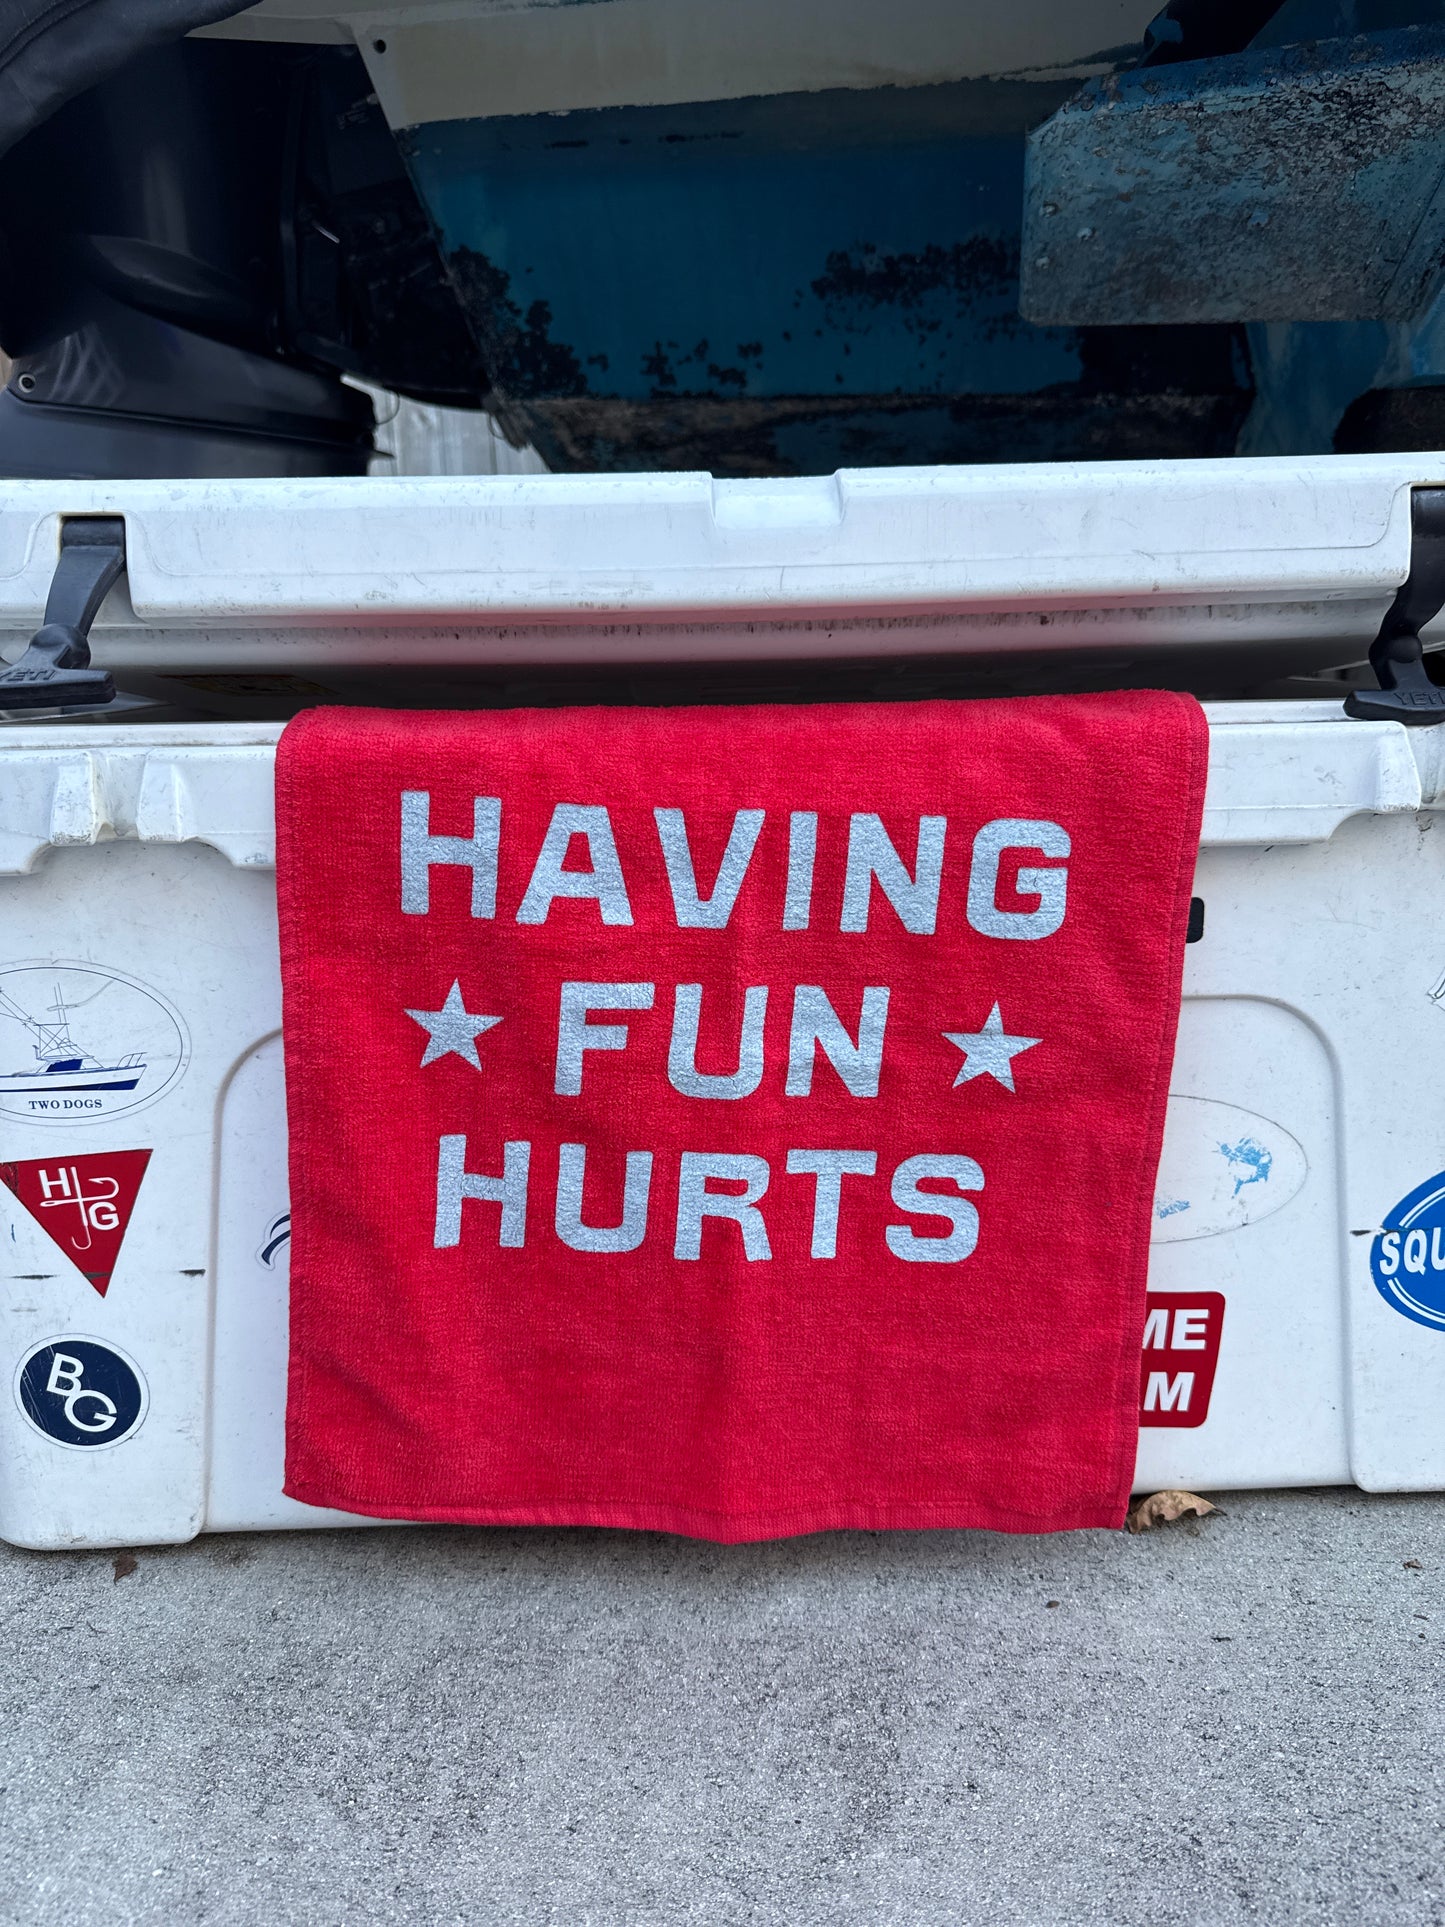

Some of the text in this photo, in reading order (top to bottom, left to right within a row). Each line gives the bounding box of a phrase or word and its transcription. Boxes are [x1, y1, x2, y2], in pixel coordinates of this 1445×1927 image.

[401, 791, 1071, 940] HAVING
[555, 982, 890, 1099] FUN
[28, 1099, 103, 1109] TWO DOGS
[434, 1135, 984, 1263] HURTS
